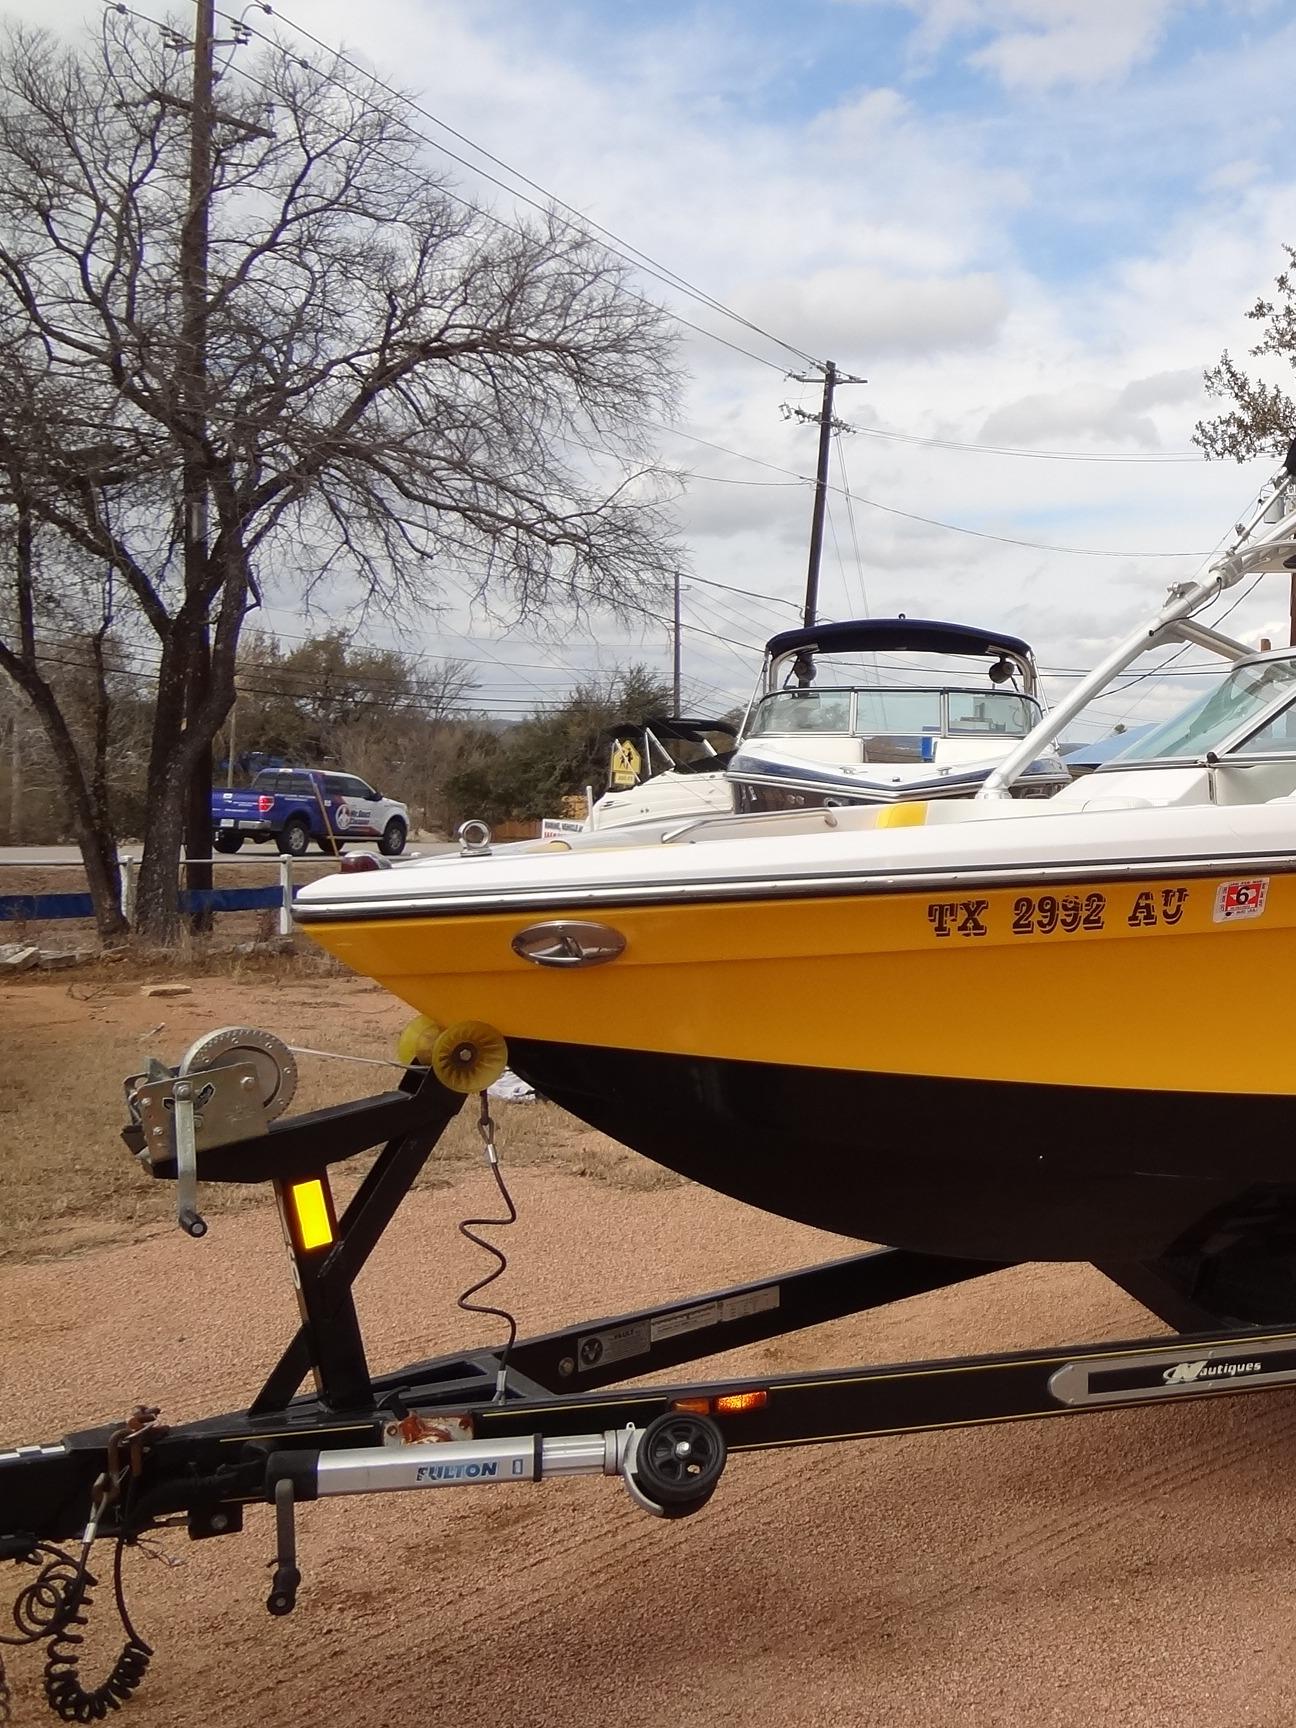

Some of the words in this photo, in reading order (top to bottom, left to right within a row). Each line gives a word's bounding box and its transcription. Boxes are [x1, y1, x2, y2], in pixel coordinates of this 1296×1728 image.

[1236, 886, 1250, 905] 6
[928, 899, 989, 937] TX
[1012, 893, 1106, 935] 2992
[1128, 888, 1189, 927] AU
[1163, 1360, 1262, 1385] Nautiques
[416, 1462, 498, 1481] FULTON
